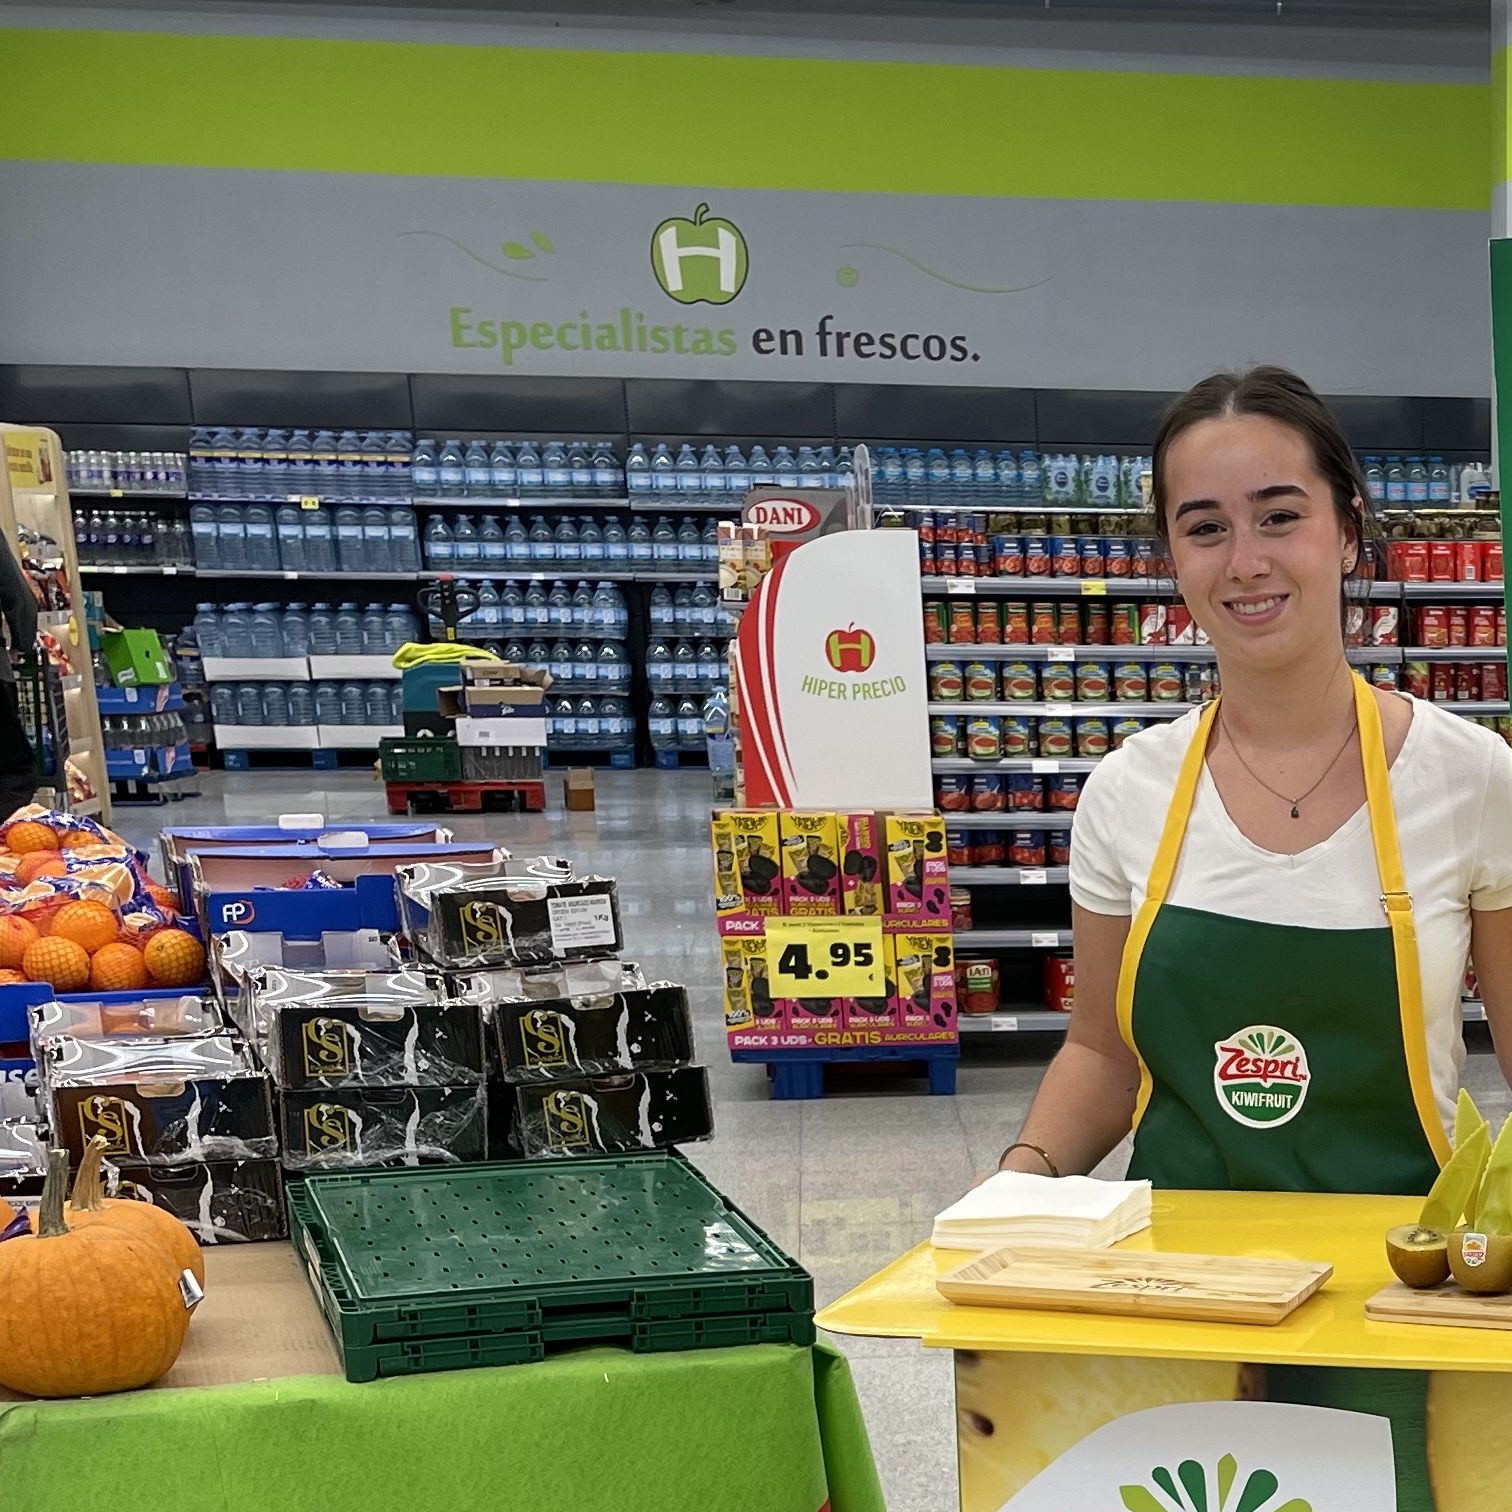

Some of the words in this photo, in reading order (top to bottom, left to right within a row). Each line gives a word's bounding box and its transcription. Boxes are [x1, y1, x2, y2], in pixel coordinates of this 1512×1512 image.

[658, 226, 737, 295] H
[449, 306, 738, 365] Especialistas
[751, 325, 803, 357] en
[815, 315, 982, 364] frescos.
[755, 507, 804, 526] DANI
[801, 675, 848, 700] HIPER
[852, 675, 907, 701] PRECIO
[222, 902, 245, 923] FP
[725, 920, 759, 931] PACK
[778, 943, 875, 980] 4.95
[735, 1036, 768, 1046] PACK
[814, 1031, 882, 1046] GRATIS
[885, 1031, 956, 1042] AURICULARES
[1219, 1046, 1306, 1083] Zespri
[1231, 1091, 1294, 1109] KIWIFRUIT
